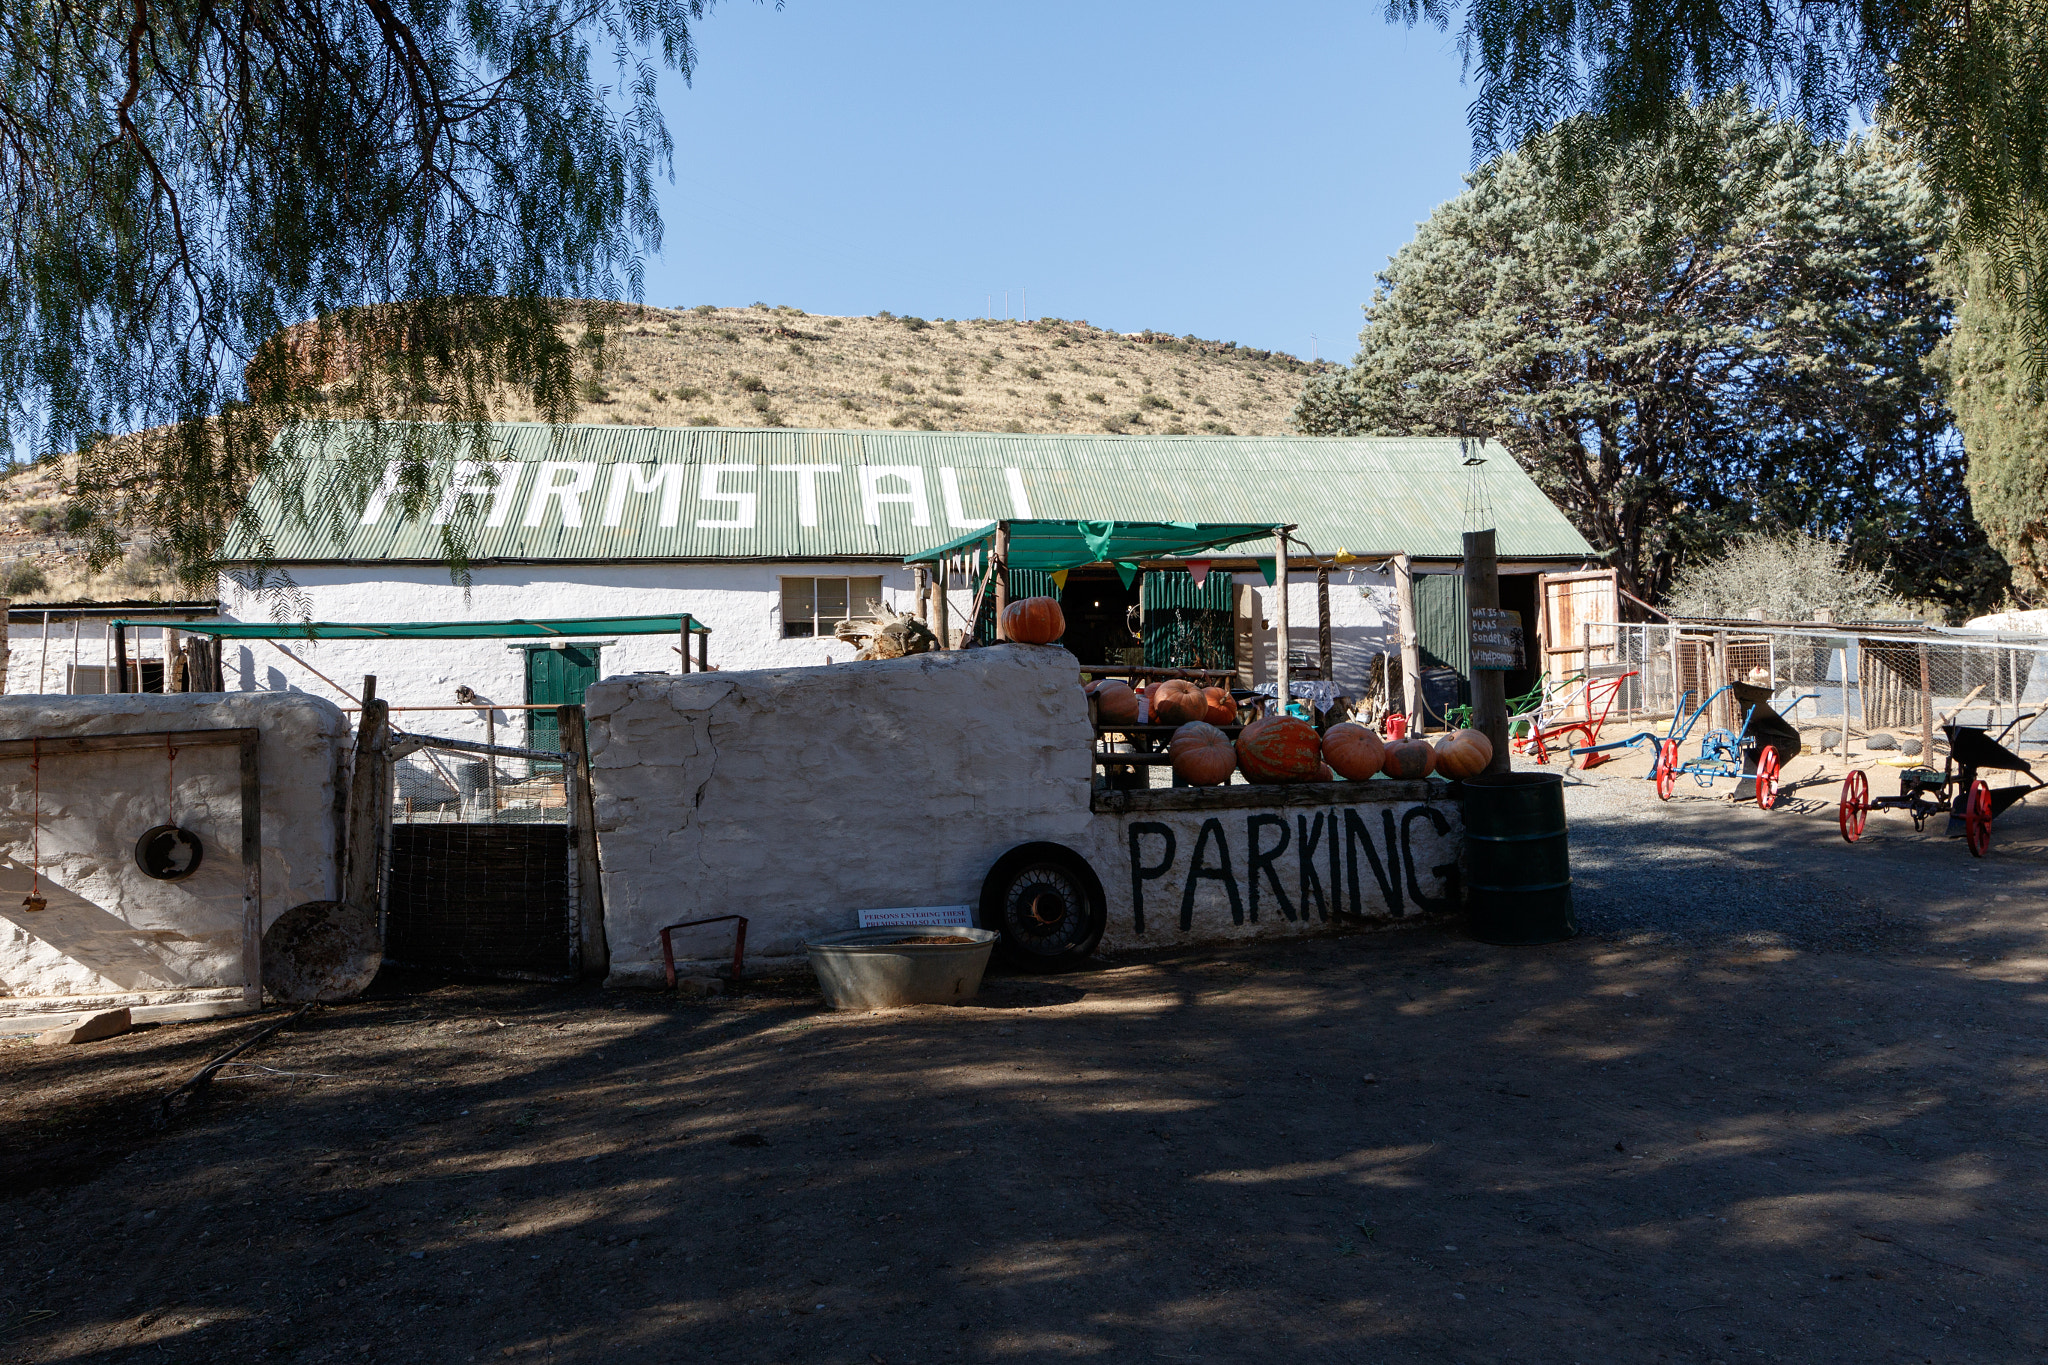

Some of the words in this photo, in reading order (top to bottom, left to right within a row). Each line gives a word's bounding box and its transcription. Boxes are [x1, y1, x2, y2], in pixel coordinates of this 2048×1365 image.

[1471, 607, 1486, 618] WAT
[1487, 608, 1497, 618] IS
[1472, 620, 1497, 631] PLAAS
[1471, 649, 1513, 665] Windpomp
[1129, 805, 1463, 934] PARKING
[900, 911, 941, 919] ENTERING
